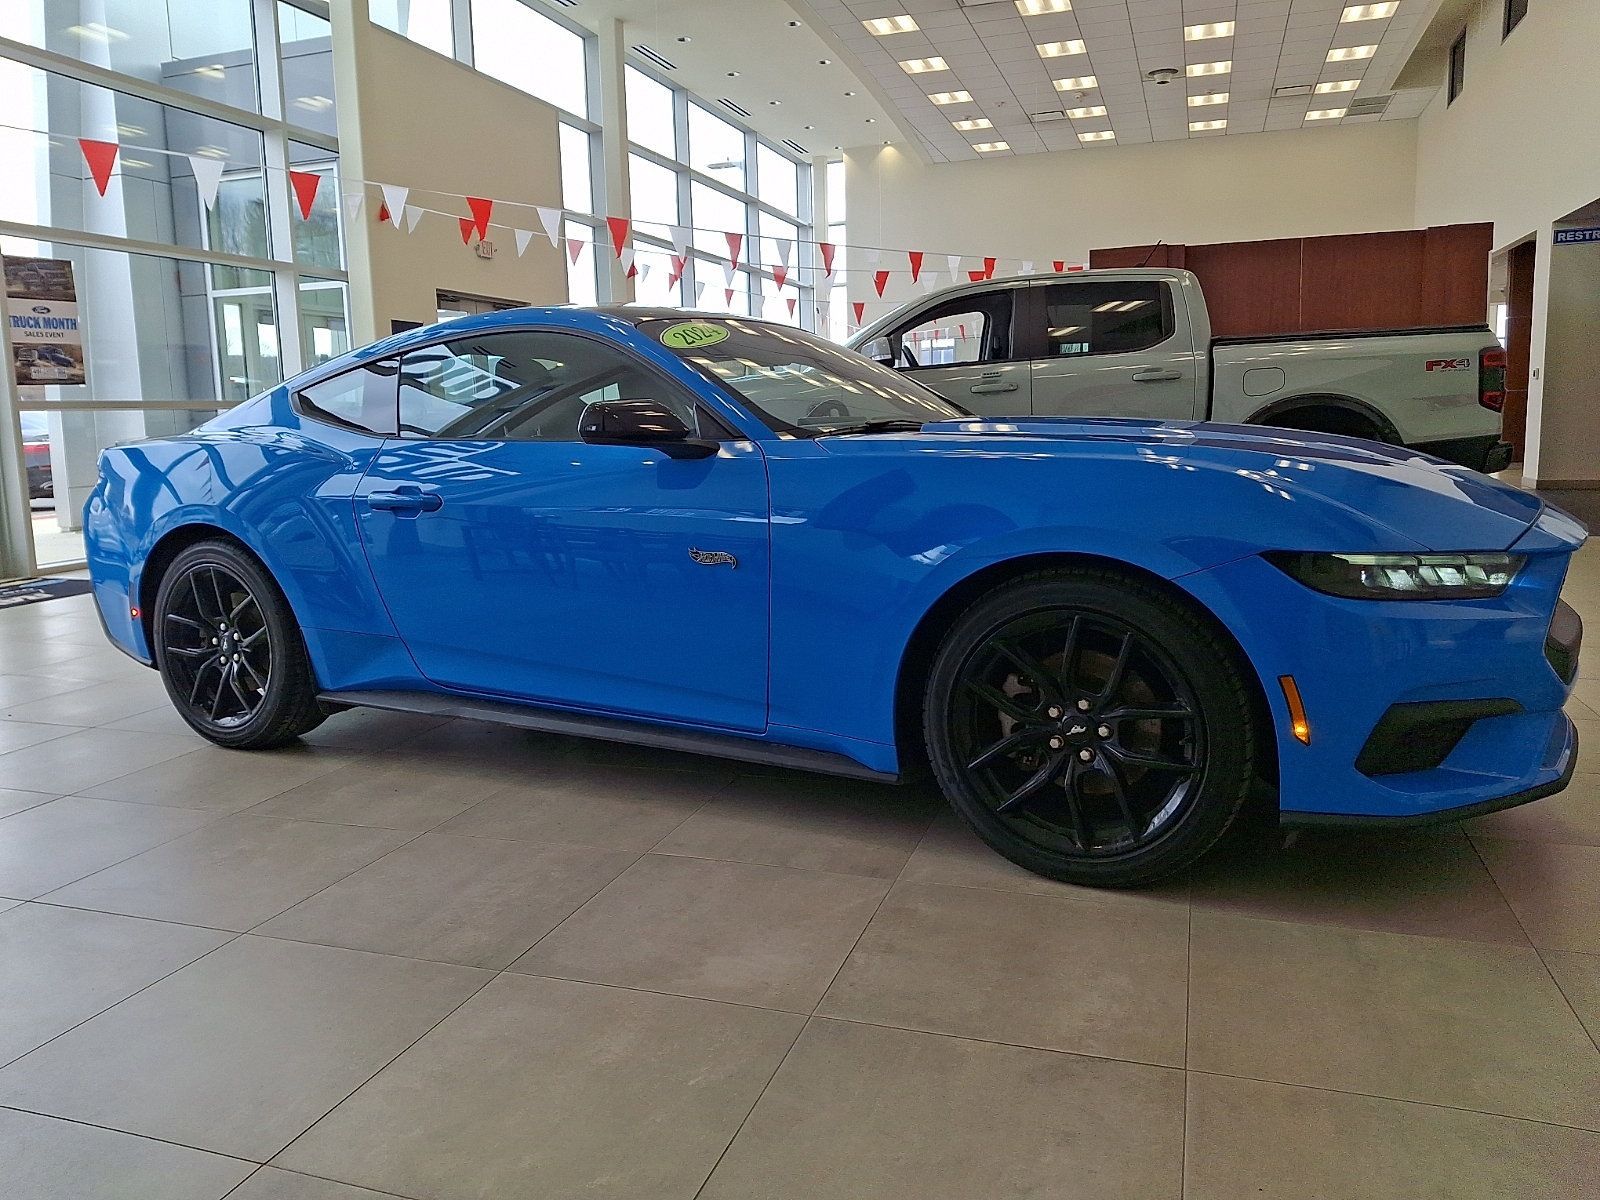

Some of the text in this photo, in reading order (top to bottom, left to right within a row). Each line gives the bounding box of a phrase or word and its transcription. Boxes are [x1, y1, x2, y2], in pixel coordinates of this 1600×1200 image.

[1557, 230, 1600, 242] RESTR
[43, 317, 77, 331] MONTH
[672, 325, 722, 345] 2024
[1425, 359, 1470, 372] FX4
